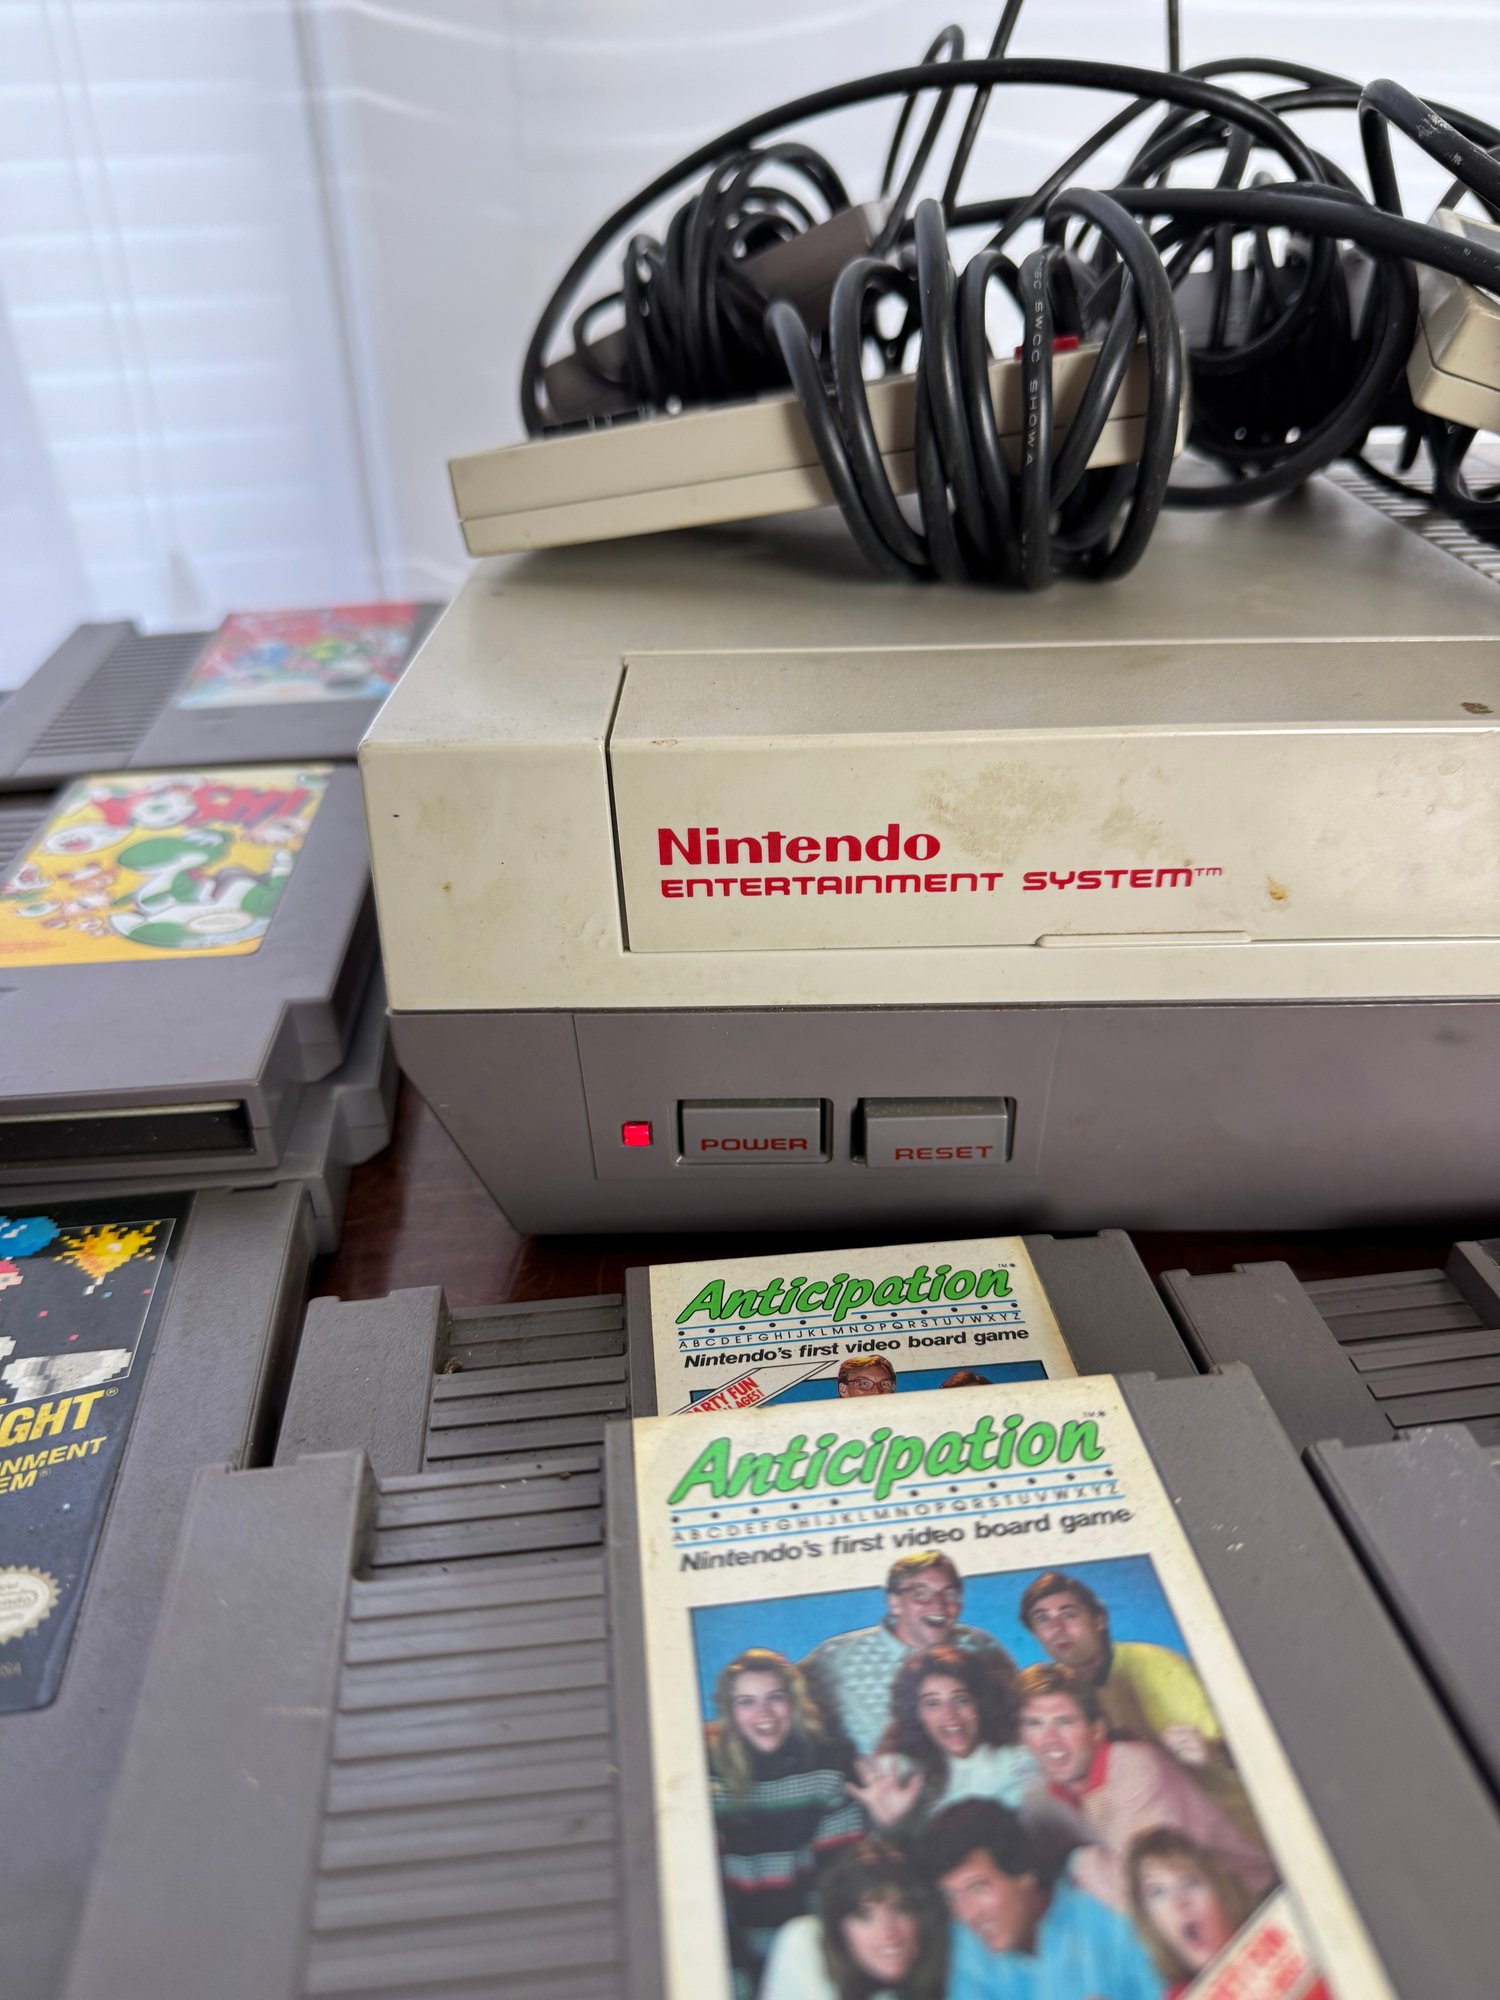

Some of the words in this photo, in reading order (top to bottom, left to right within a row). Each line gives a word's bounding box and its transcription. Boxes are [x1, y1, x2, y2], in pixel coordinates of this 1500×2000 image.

[1031, 301, 1043, 363] SWCC
[1026, 379, 1038, 466] SHOWA
[658, 823, 941, 866] Nintendo
[661, 872, 1003, 898] ENTERTAINMENT
[1022, 868, 1194, 892] SYSTEM
[701, 1137, 808, 1152] POWER
[894, 1145, 994, 1161] RESET
[675, 1264, 1013, 1325] Anticipation
[684, 1347, 793, 1369] Nintendo's
[799, 1342, 839, 1358] first
[845, 1339, 900, 1354] video
[908, 1331, 967, 1349] board
[973, 1329, 1029, 1346] game
[0, 1389, 106, 1448] GHT
[684, 1391, 729, 1414] ARTY
[726, 1376, 760, 1400] FUN
[666, 1413, 1105, 1506] Anticipation
[679, 1540, 823, 1572] Nintendo's
[832, 1533, 884, 1555] first
[892, 1527, 965, 1548] video
[974, 1513, 1050, 1540] board
[1060, 1508, 1133, 1534] game
